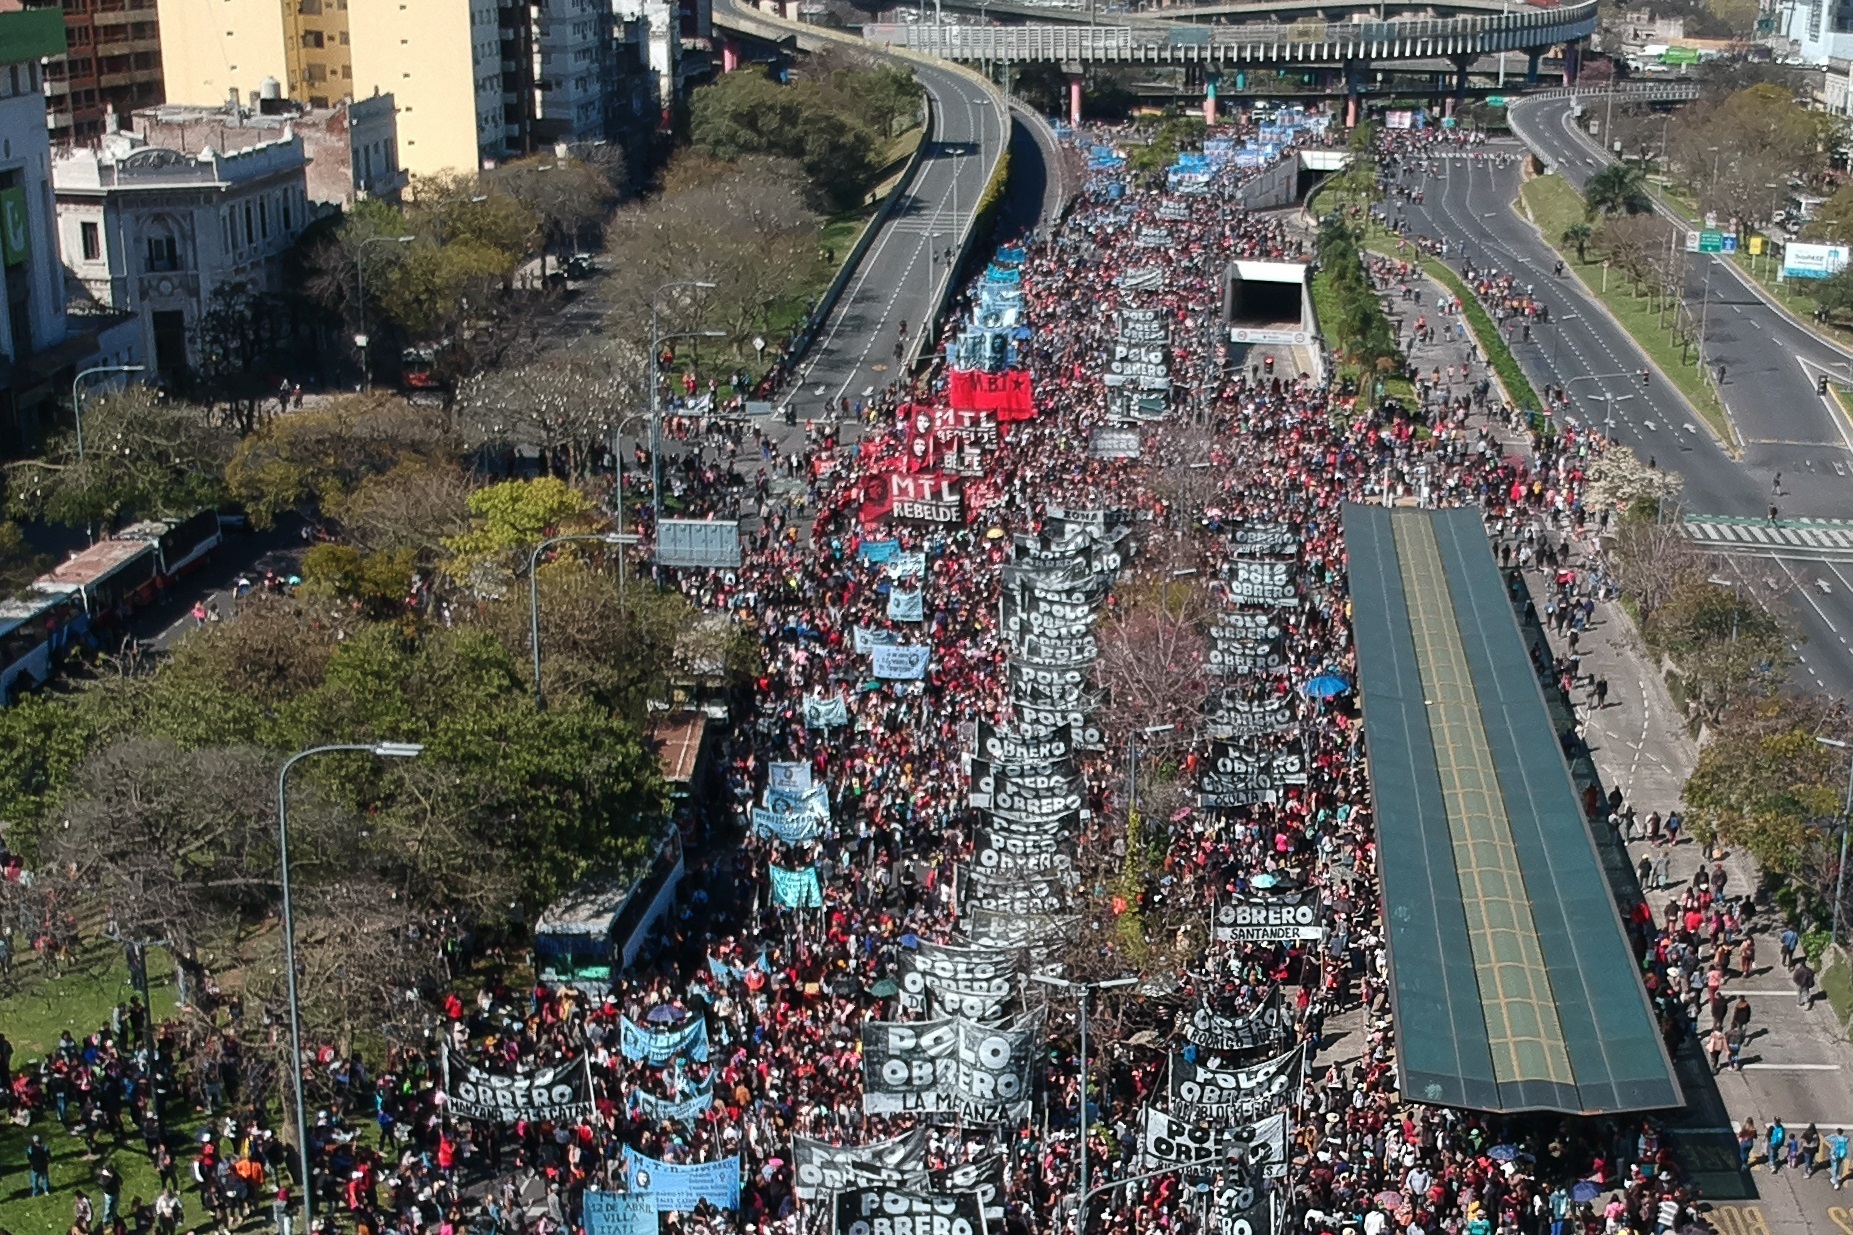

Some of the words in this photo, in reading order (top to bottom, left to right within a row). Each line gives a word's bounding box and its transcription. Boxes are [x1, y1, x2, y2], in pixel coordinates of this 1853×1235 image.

[1115, 346, 1163, 364] POLO
[891, 475, 961, 501] MTL
[892, 501, 962, 522] REBELDE
[1231, 580, 1295, 598] OBRERO
[1039, 601, 1090, 620] POLO
[1209, 650, 1280, 669] OBRERO
[1022, 667, 1082, 684] POLO
[996, 793, 1082, 814] OBRERO
[1218, 905, 1314, 925] OBRERO
[1230, 927, 1301, 941] SANTANDER
[915, 954, 996, 979] POLO
[888, 1025, 1011, 1070] POLO
[882, 1058, 1020, 1099] OBRERO
[1195, 1065, 1277, 1090] POLO
[458, 1080, 573, 1109] OBRERO
[903, 1094, 925, 1110] LA
[605, 1202, 618, 1213] DE
[626, 1202, 655, 1215] ABRIL
[861, 1191, 957, 1217] POLO
[603, 1212, 640, 1223] VILLA
